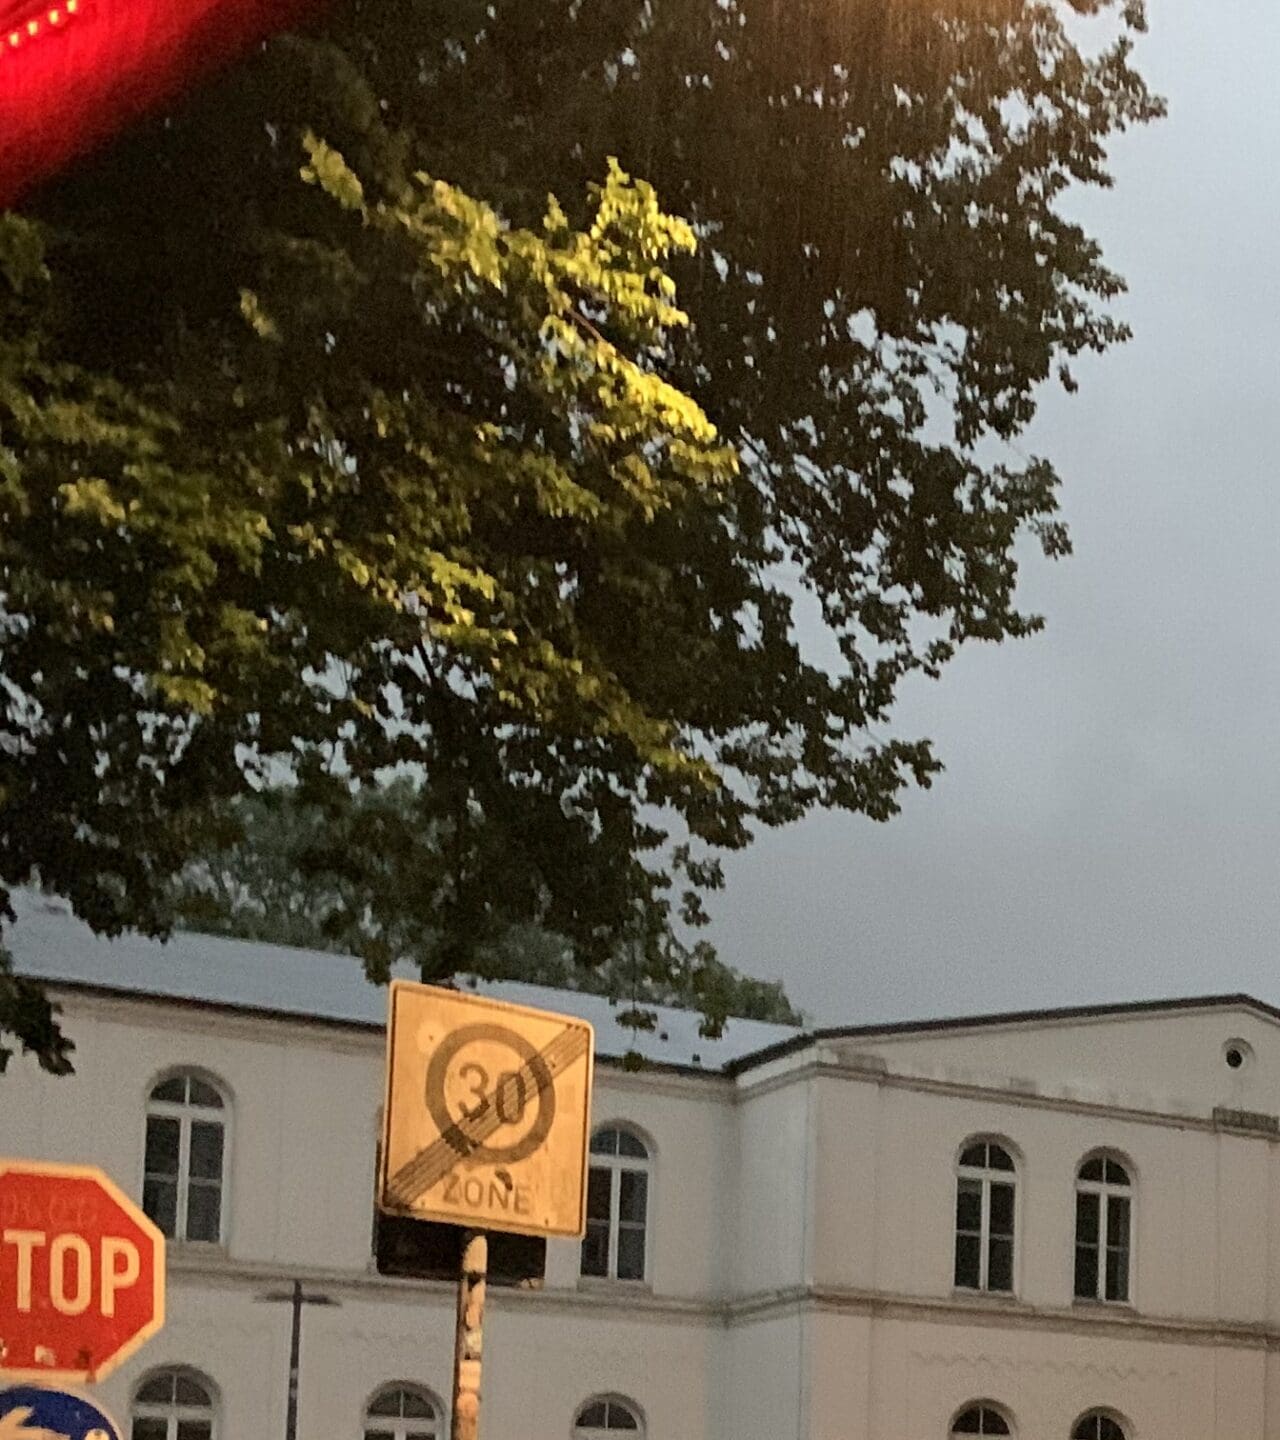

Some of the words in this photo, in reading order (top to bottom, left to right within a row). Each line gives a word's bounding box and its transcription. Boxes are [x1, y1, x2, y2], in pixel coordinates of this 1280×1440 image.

[458, 1062, 526, 1125] 30
[442, 1173, 532, 1215] ZONE
[3, 1228, 140, 1318] TOP
